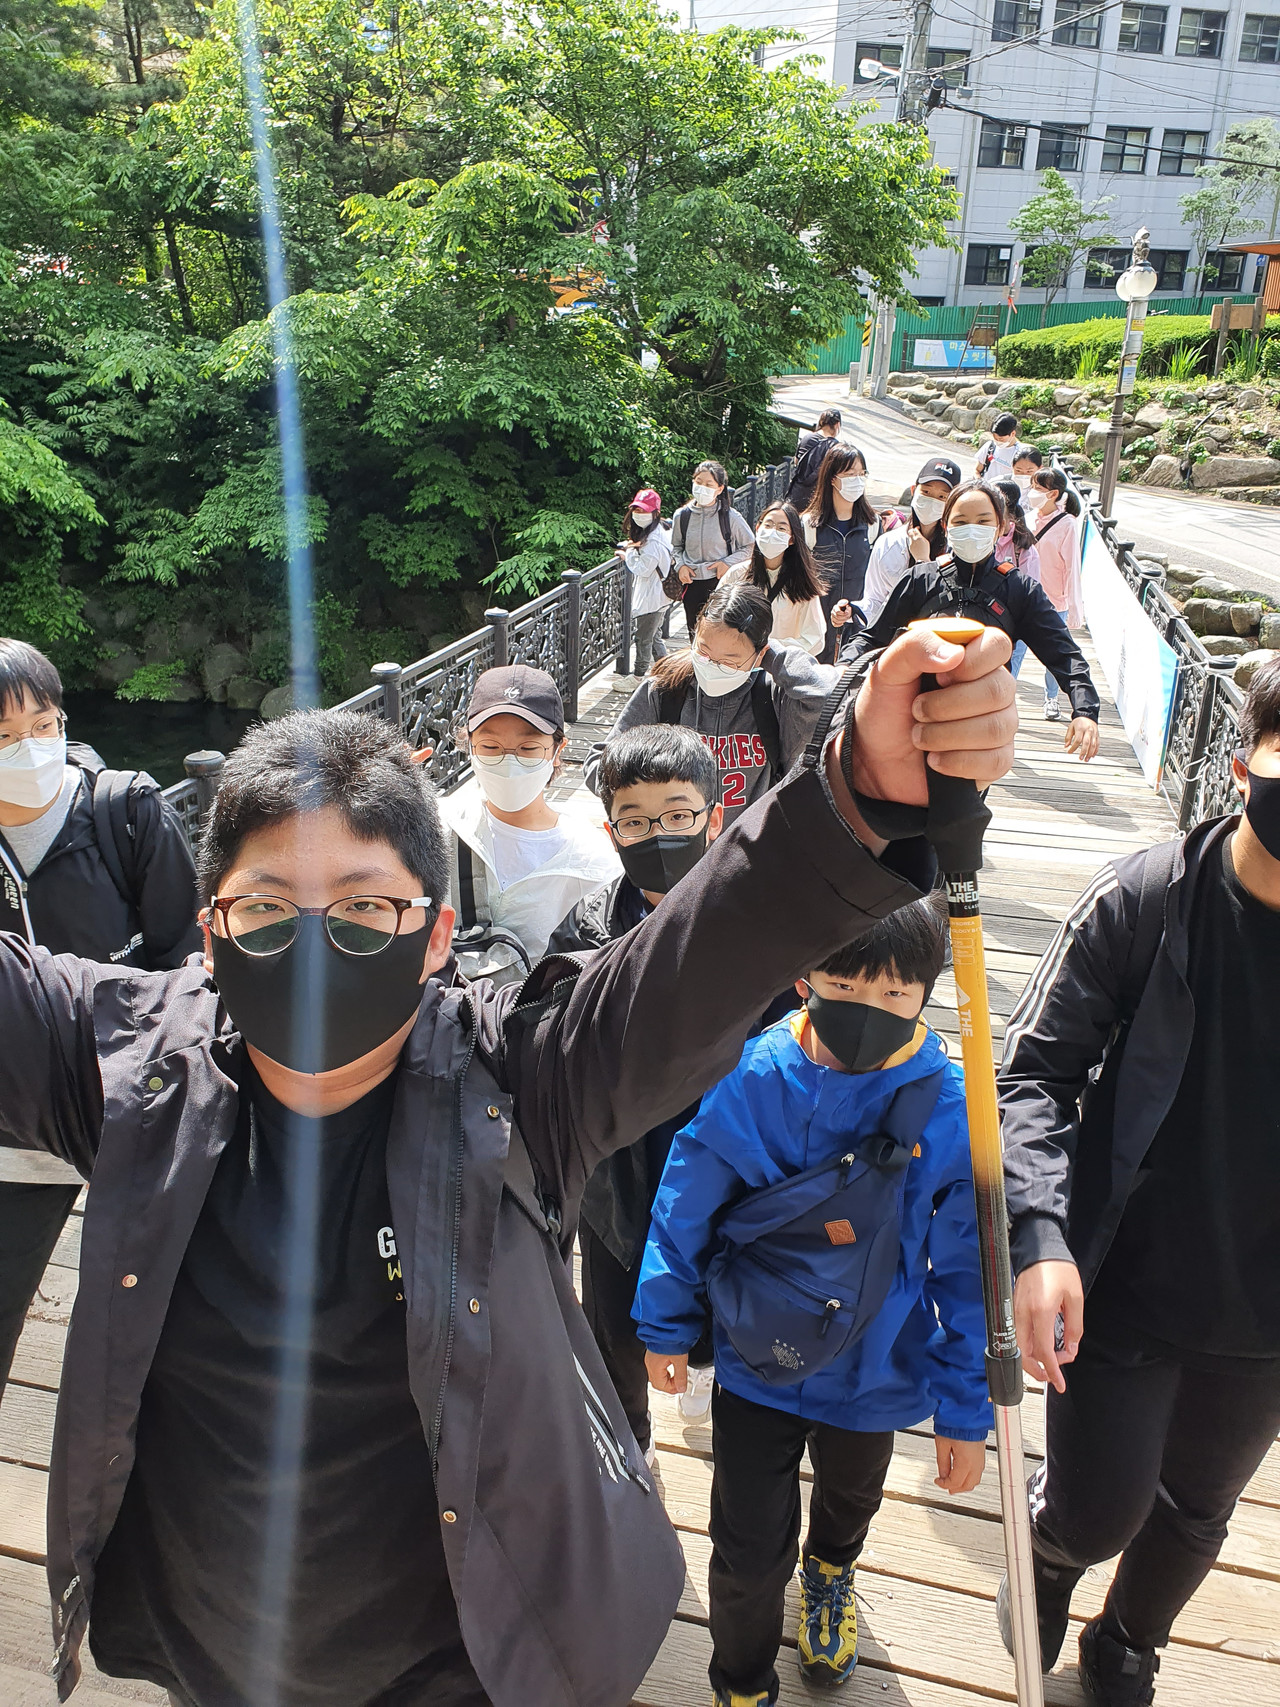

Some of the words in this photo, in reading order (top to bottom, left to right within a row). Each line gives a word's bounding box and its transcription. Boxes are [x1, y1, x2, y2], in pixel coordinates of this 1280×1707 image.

[934, 462, 954, 475] FILA
[722, 771, 747, 808] 2
[951, 880, 975, 893] THE
[959, 1008, 974, 1038] THE
